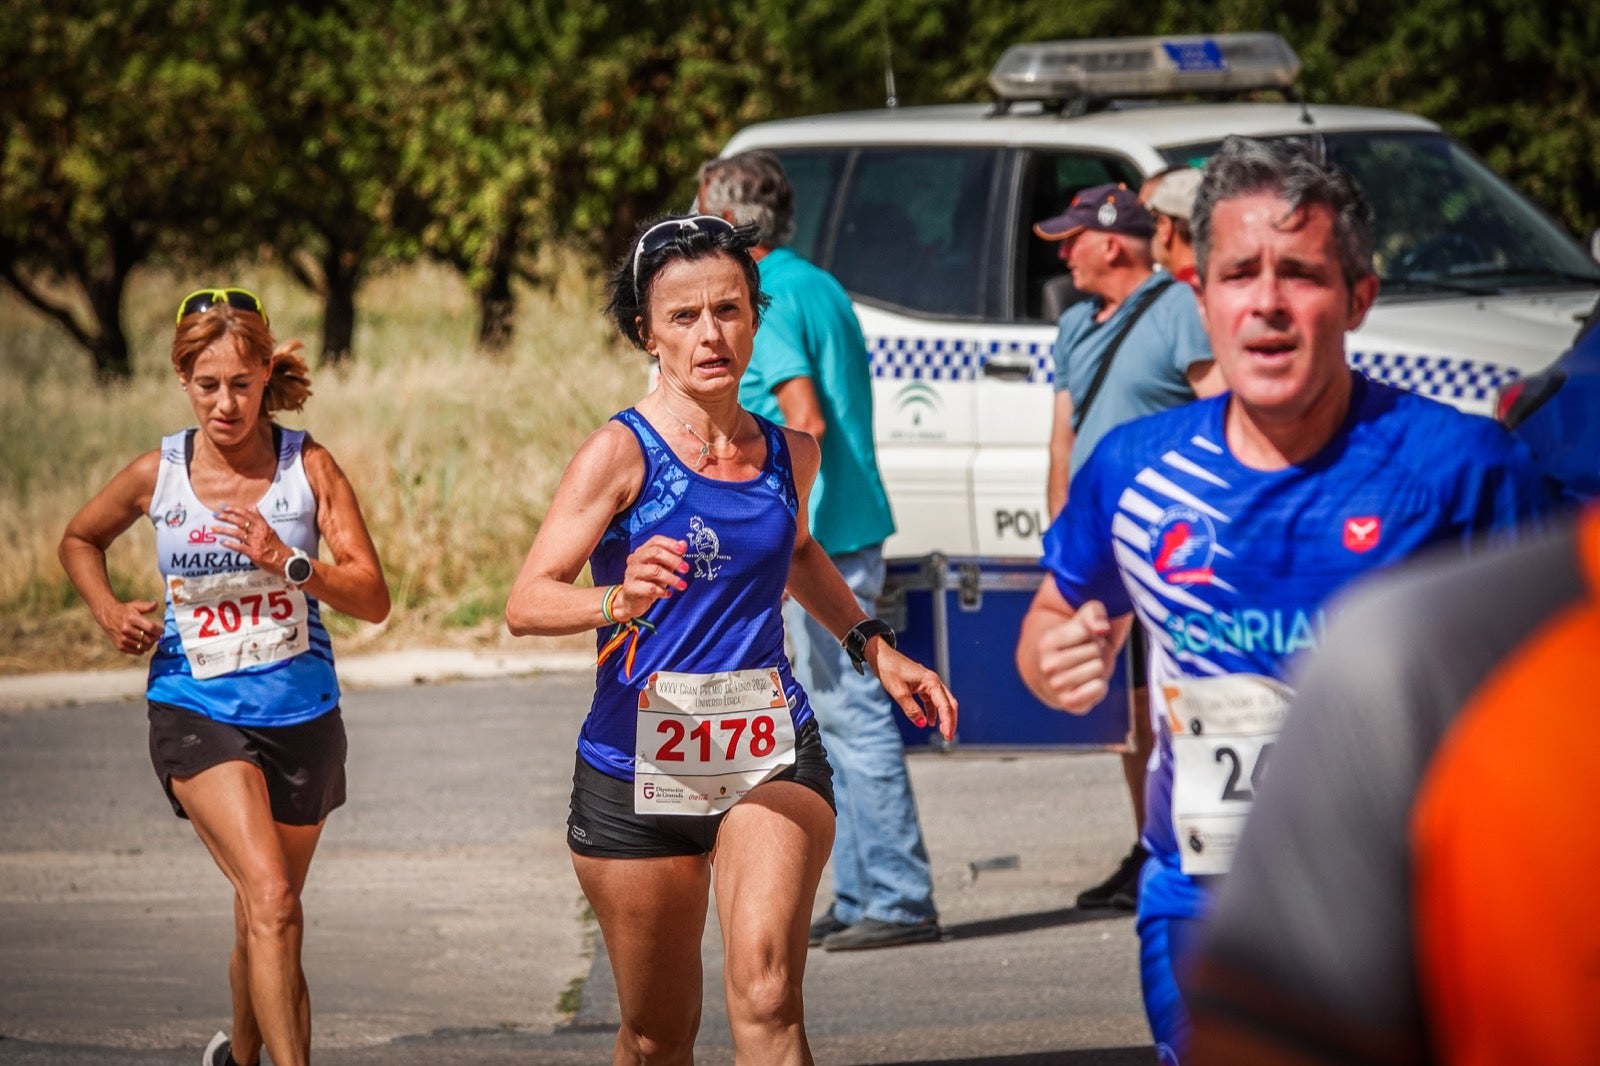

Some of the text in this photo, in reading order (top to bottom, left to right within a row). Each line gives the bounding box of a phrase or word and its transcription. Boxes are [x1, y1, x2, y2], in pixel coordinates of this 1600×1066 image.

[171, 552, 259, 569] MARAC
[193, 590, 293, 638] 2075
[656, 715, 776, 762] 2178
